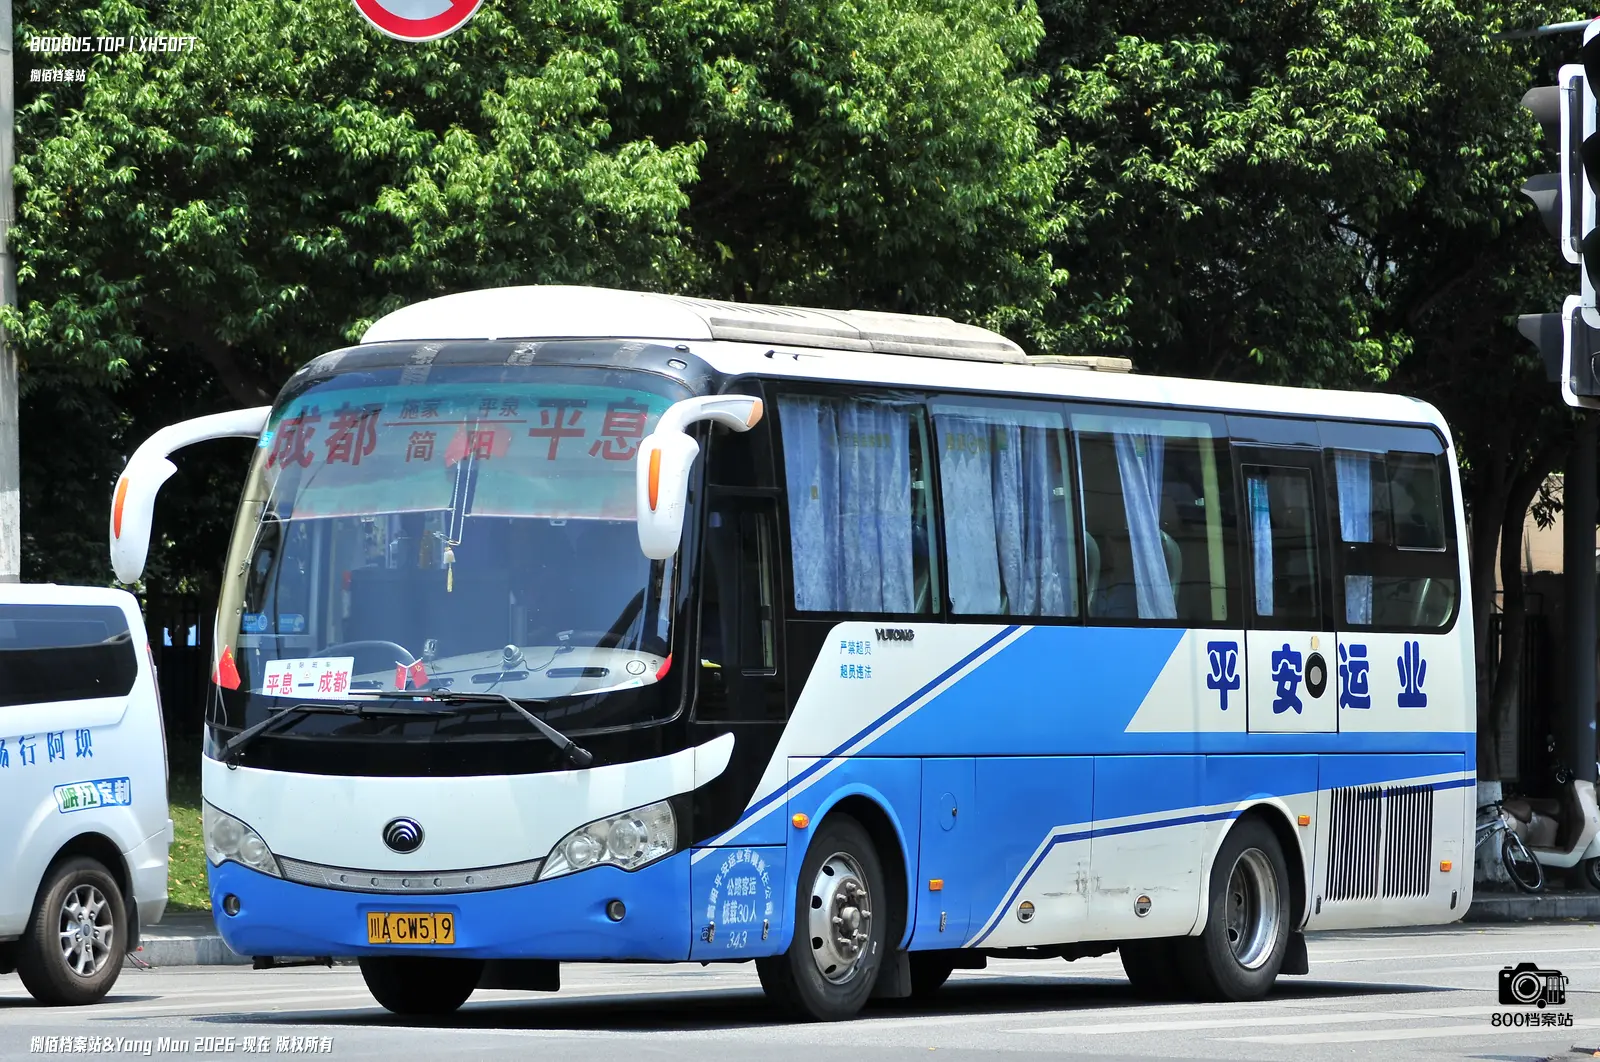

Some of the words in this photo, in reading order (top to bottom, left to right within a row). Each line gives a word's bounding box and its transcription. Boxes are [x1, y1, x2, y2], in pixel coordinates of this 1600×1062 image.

[399, 399, 444, 420] 施家
[477, 397, 520, 419] 平泉
[264, 401, 385, 470] 成都
[528, 396, 649, 461] 平息
[405, 429, 496, 463] 简阳
[875, 628, 915, 641] YUTONG
[839, 640, 872, 656] 严禁超员
[839, 664, 872, 680] 超员违法
[1206, 641, 1428, 715] 平安运业
[59, 779, 130, 810] 岷江定制
[726, 876, 757, 896] 公路客运
[722, 899, 758, 925] 核载30人
[726, 930, 748, 949] 343
